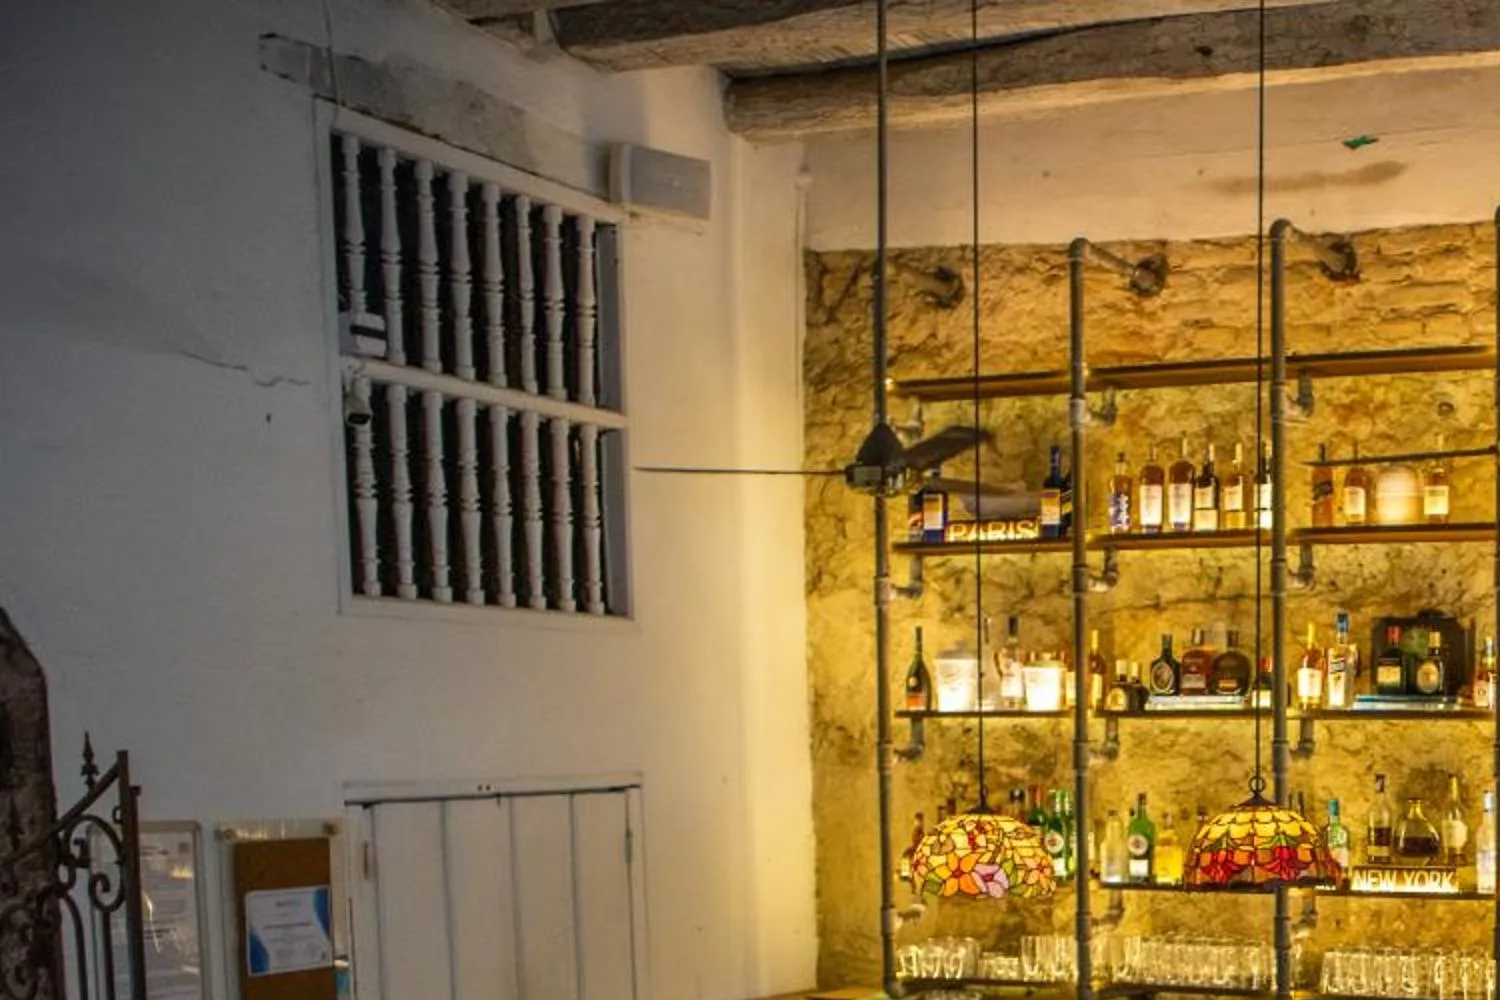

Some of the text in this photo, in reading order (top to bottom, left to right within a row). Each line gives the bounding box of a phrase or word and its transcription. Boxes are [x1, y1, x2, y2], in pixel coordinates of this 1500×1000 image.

[949, 519, 1036, 542] PARIS
[1352, 869, 1455, 892] NEW YORK
